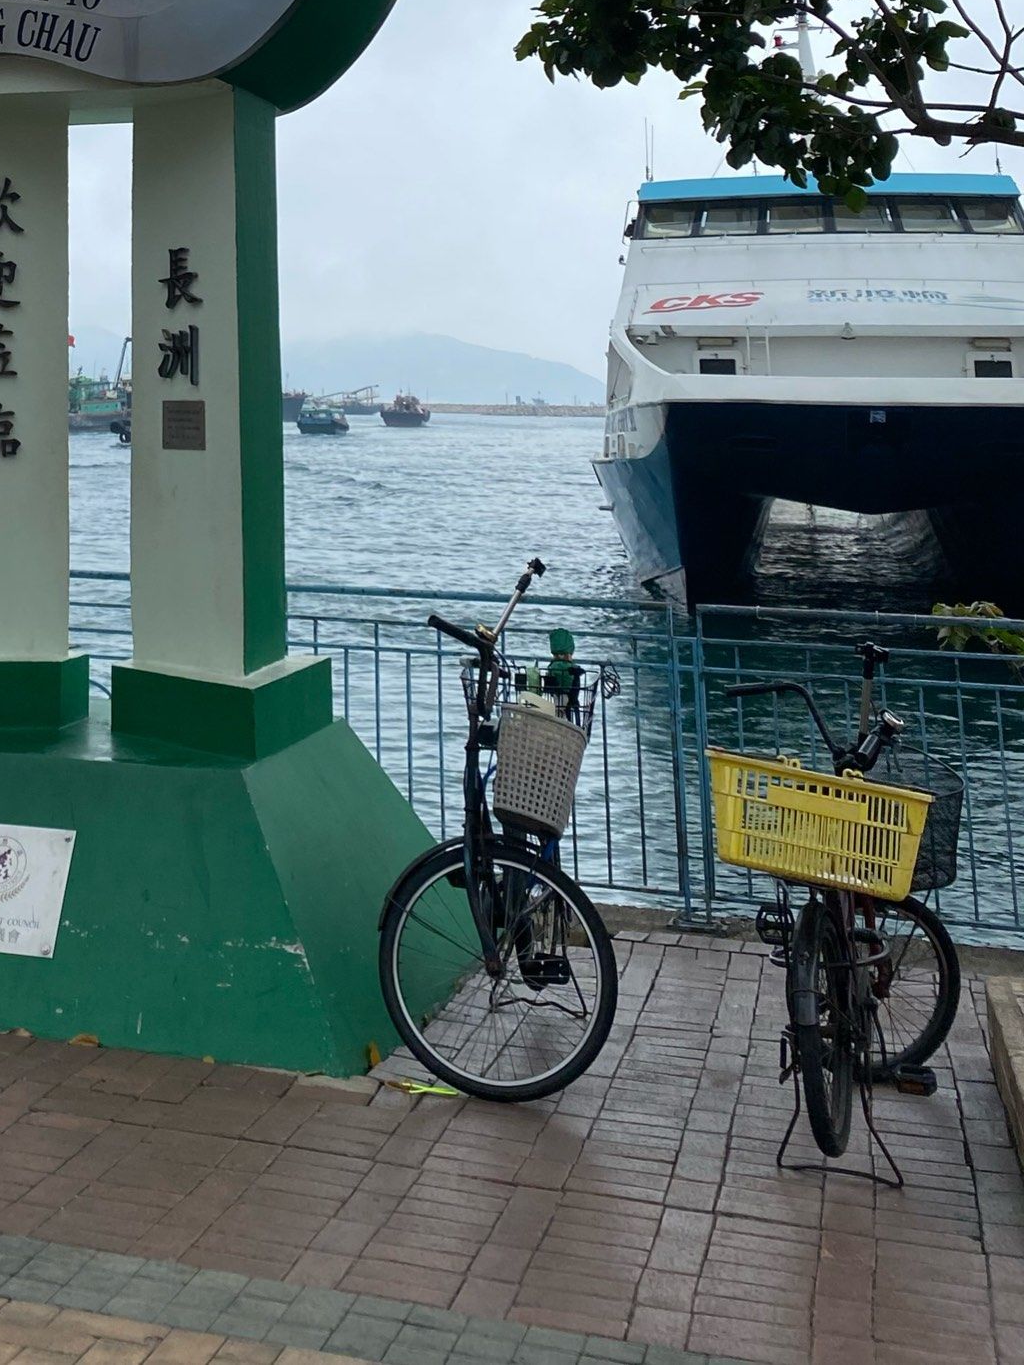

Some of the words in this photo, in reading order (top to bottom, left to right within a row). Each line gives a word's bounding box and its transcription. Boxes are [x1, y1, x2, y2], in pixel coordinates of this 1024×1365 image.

[17, 9, 102, 63] CHAU
[157, 246, 204, 387] 長洲
[648, 291, 765, 312] CKS
